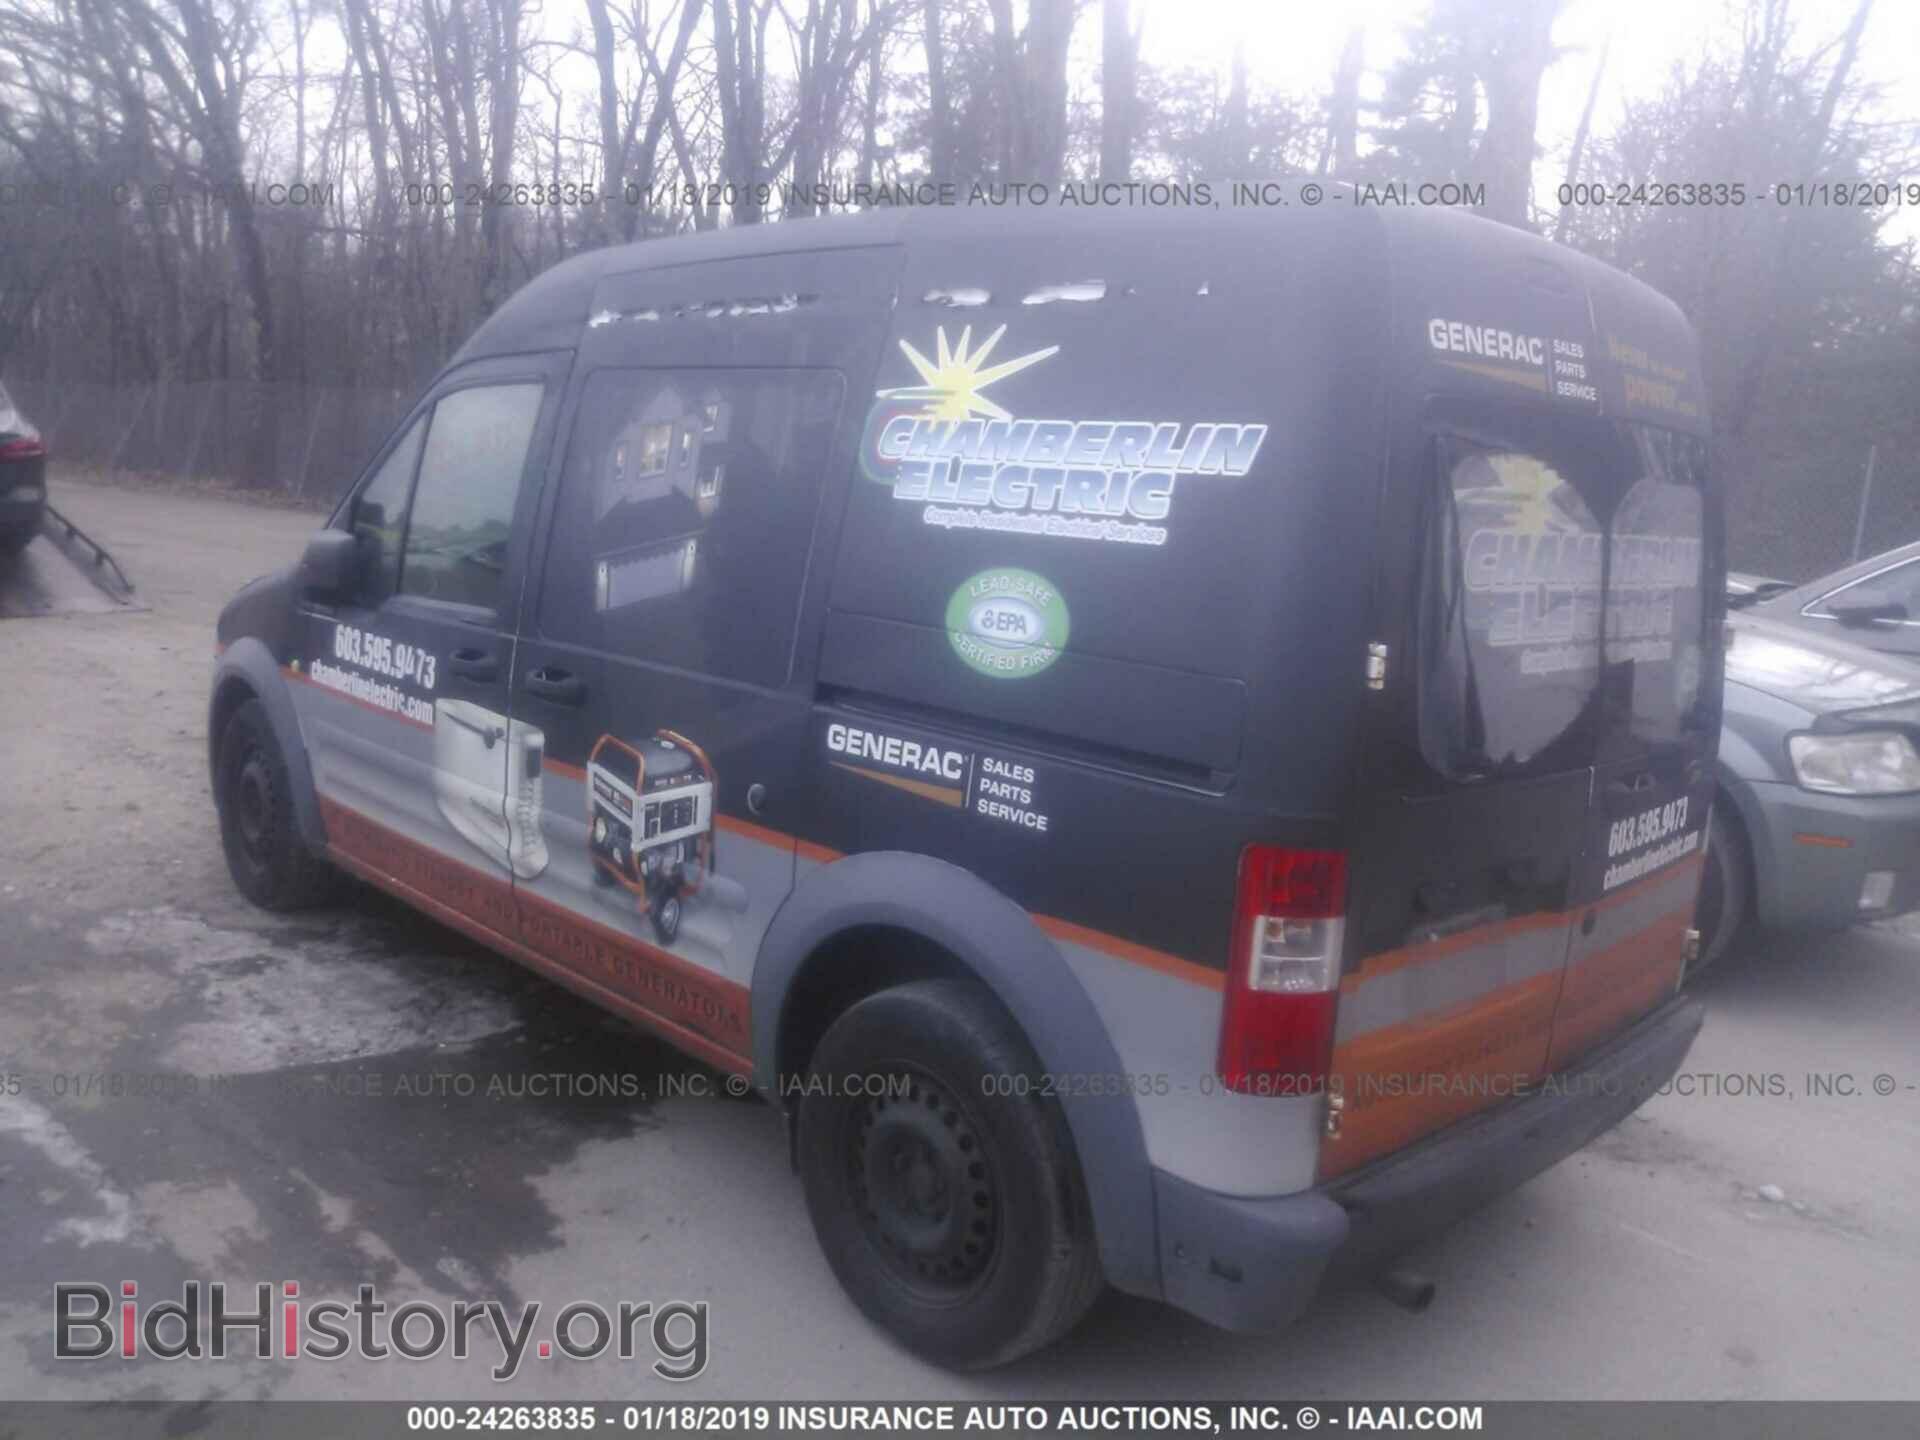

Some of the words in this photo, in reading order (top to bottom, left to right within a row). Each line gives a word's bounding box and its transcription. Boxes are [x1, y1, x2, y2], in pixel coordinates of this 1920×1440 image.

[1428, 319, 1544, 364] GENERAC
[1553, 339, 1585, 358] SALES
[1555, 360, 1586, 378] PARTS
[1557, 380, 1598, 401] SERVICE
[878, 415, 1268, 476] CHAMBERLIN
[893, 459, 1176, 519] ELECTRIC
[996, 611, 1027, 635] EPA
[335, 624, 436, 689] 603.595.9473
[827, 723, 963, 780] GENERAC
[982, 757, 1035, 783] SALES
[979, 778, 1032, 804] PARTS
[977, 799, 1049, 831] SERVICE
